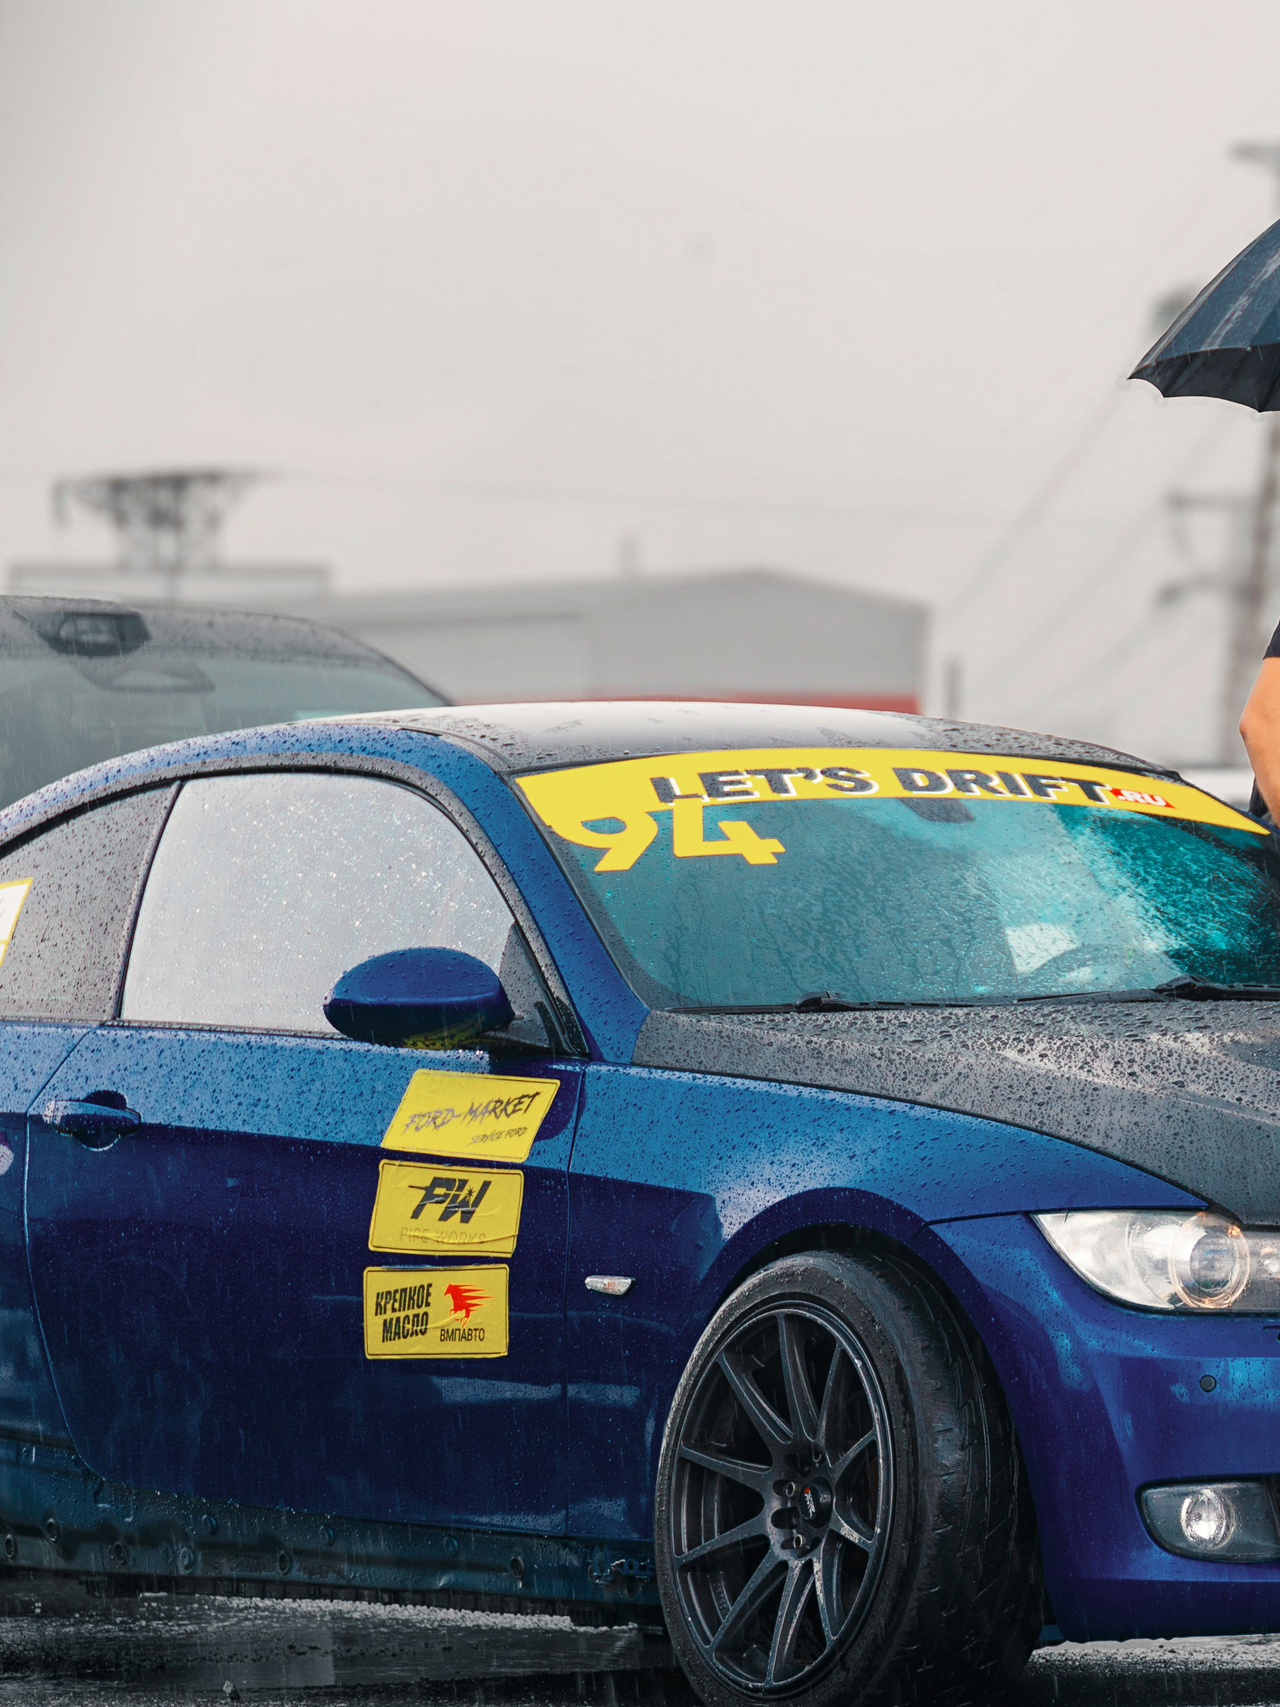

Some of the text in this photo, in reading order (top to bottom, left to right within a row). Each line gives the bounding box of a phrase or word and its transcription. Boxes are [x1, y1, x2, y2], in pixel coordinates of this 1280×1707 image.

[649, 766, 876, 804] LET'S
[547, 795, 786, 873] 94
[404, 1091, 543, 1137] FORD-MARKET
[469, 1127, 528, 1147] SERVICE FORD
[408, 1177, 492, 1224] PW
[400, 1227, 488, 1245] PIPE WORKS
[374, 1283, 433, 1316] КРЕПКОЕ
[382, 1312, 429, 1342] МАСЛО
[439, 1328, 485, 1342] ВМПАВТО
